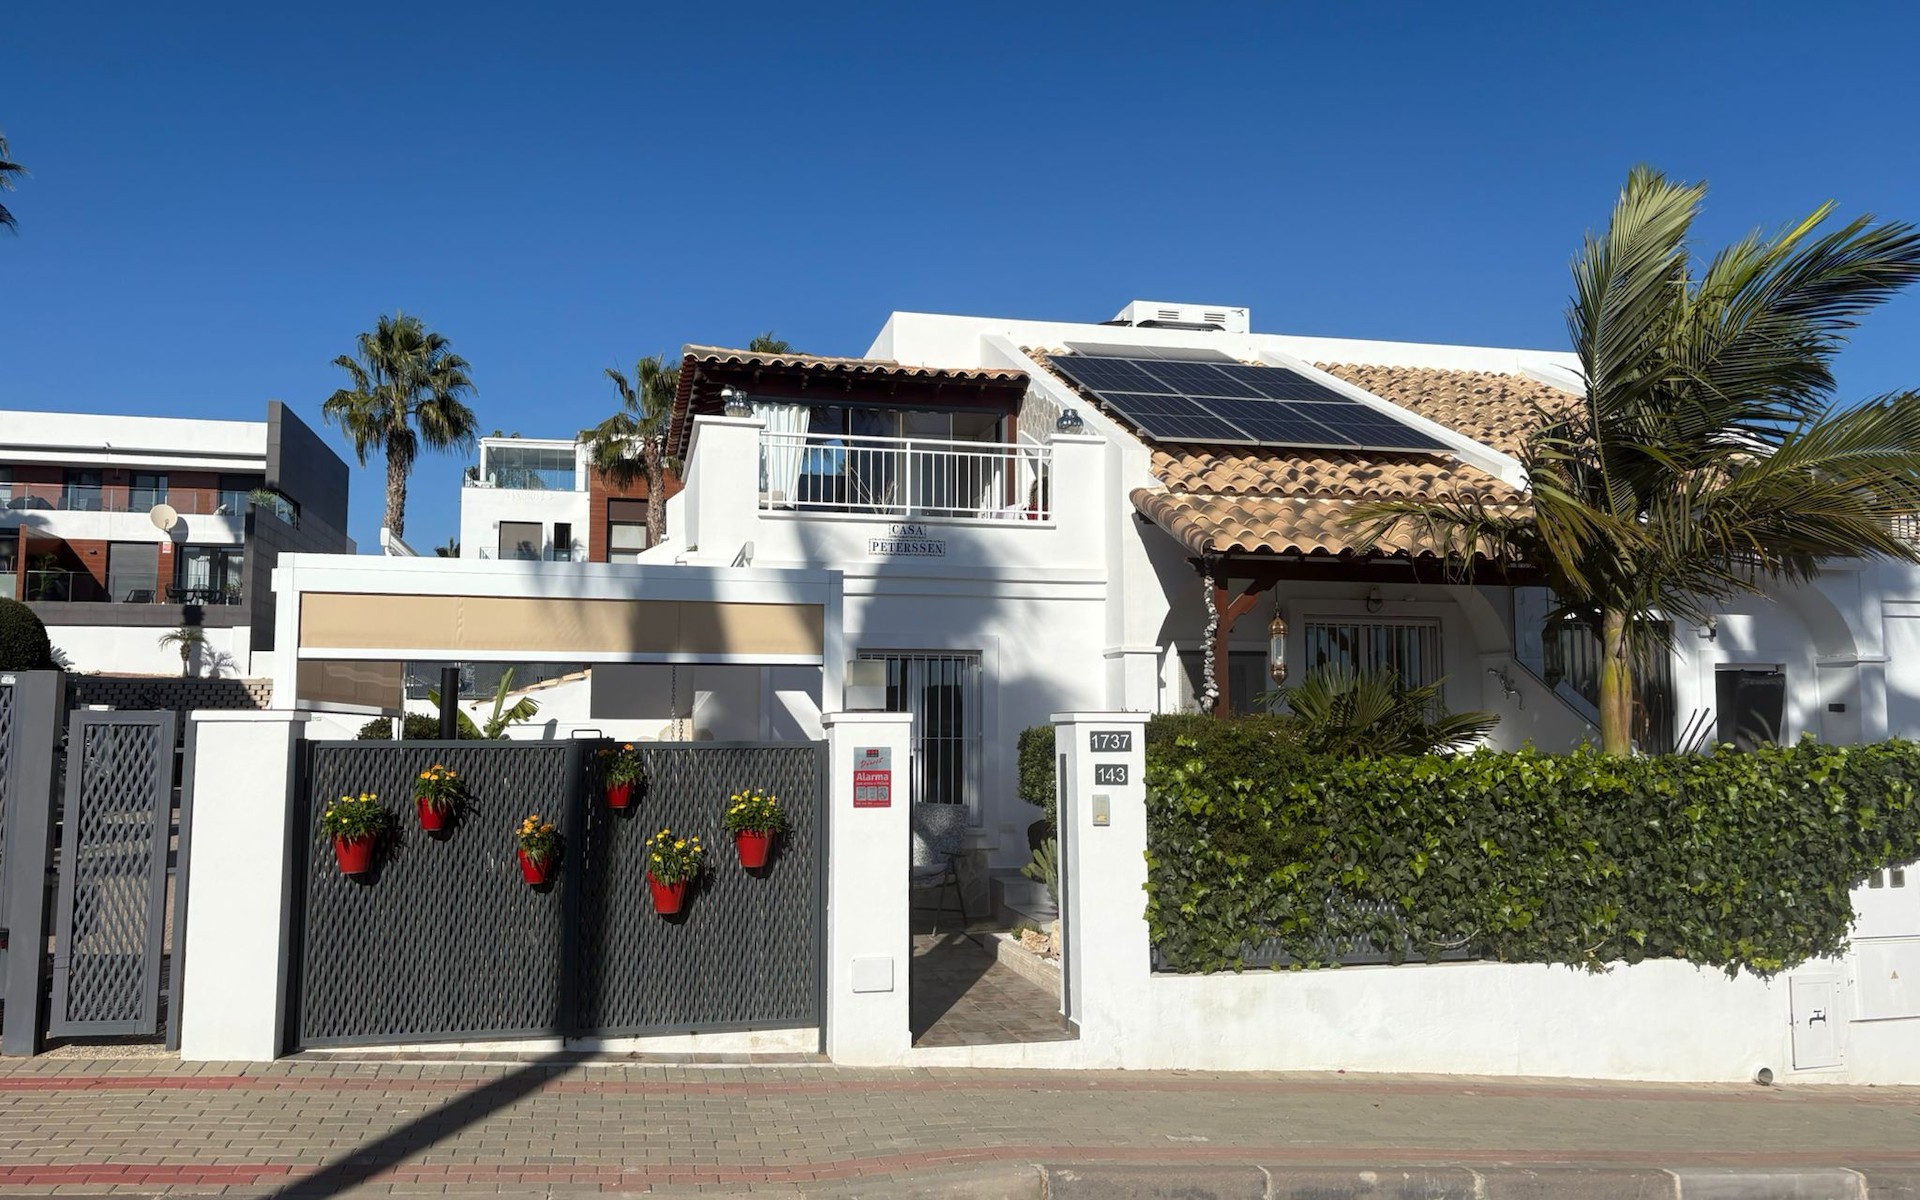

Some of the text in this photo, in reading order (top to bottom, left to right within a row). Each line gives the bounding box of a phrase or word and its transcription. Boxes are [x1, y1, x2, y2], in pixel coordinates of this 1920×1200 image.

[892, 525, 923, 536] CASA
[872, 542, 943, 554] PETERSSEN
[1091, 734, 1129, 749] 1737
[856, 772, 889, 781] Alarma
[1098, 767, 1126, 782] 143
